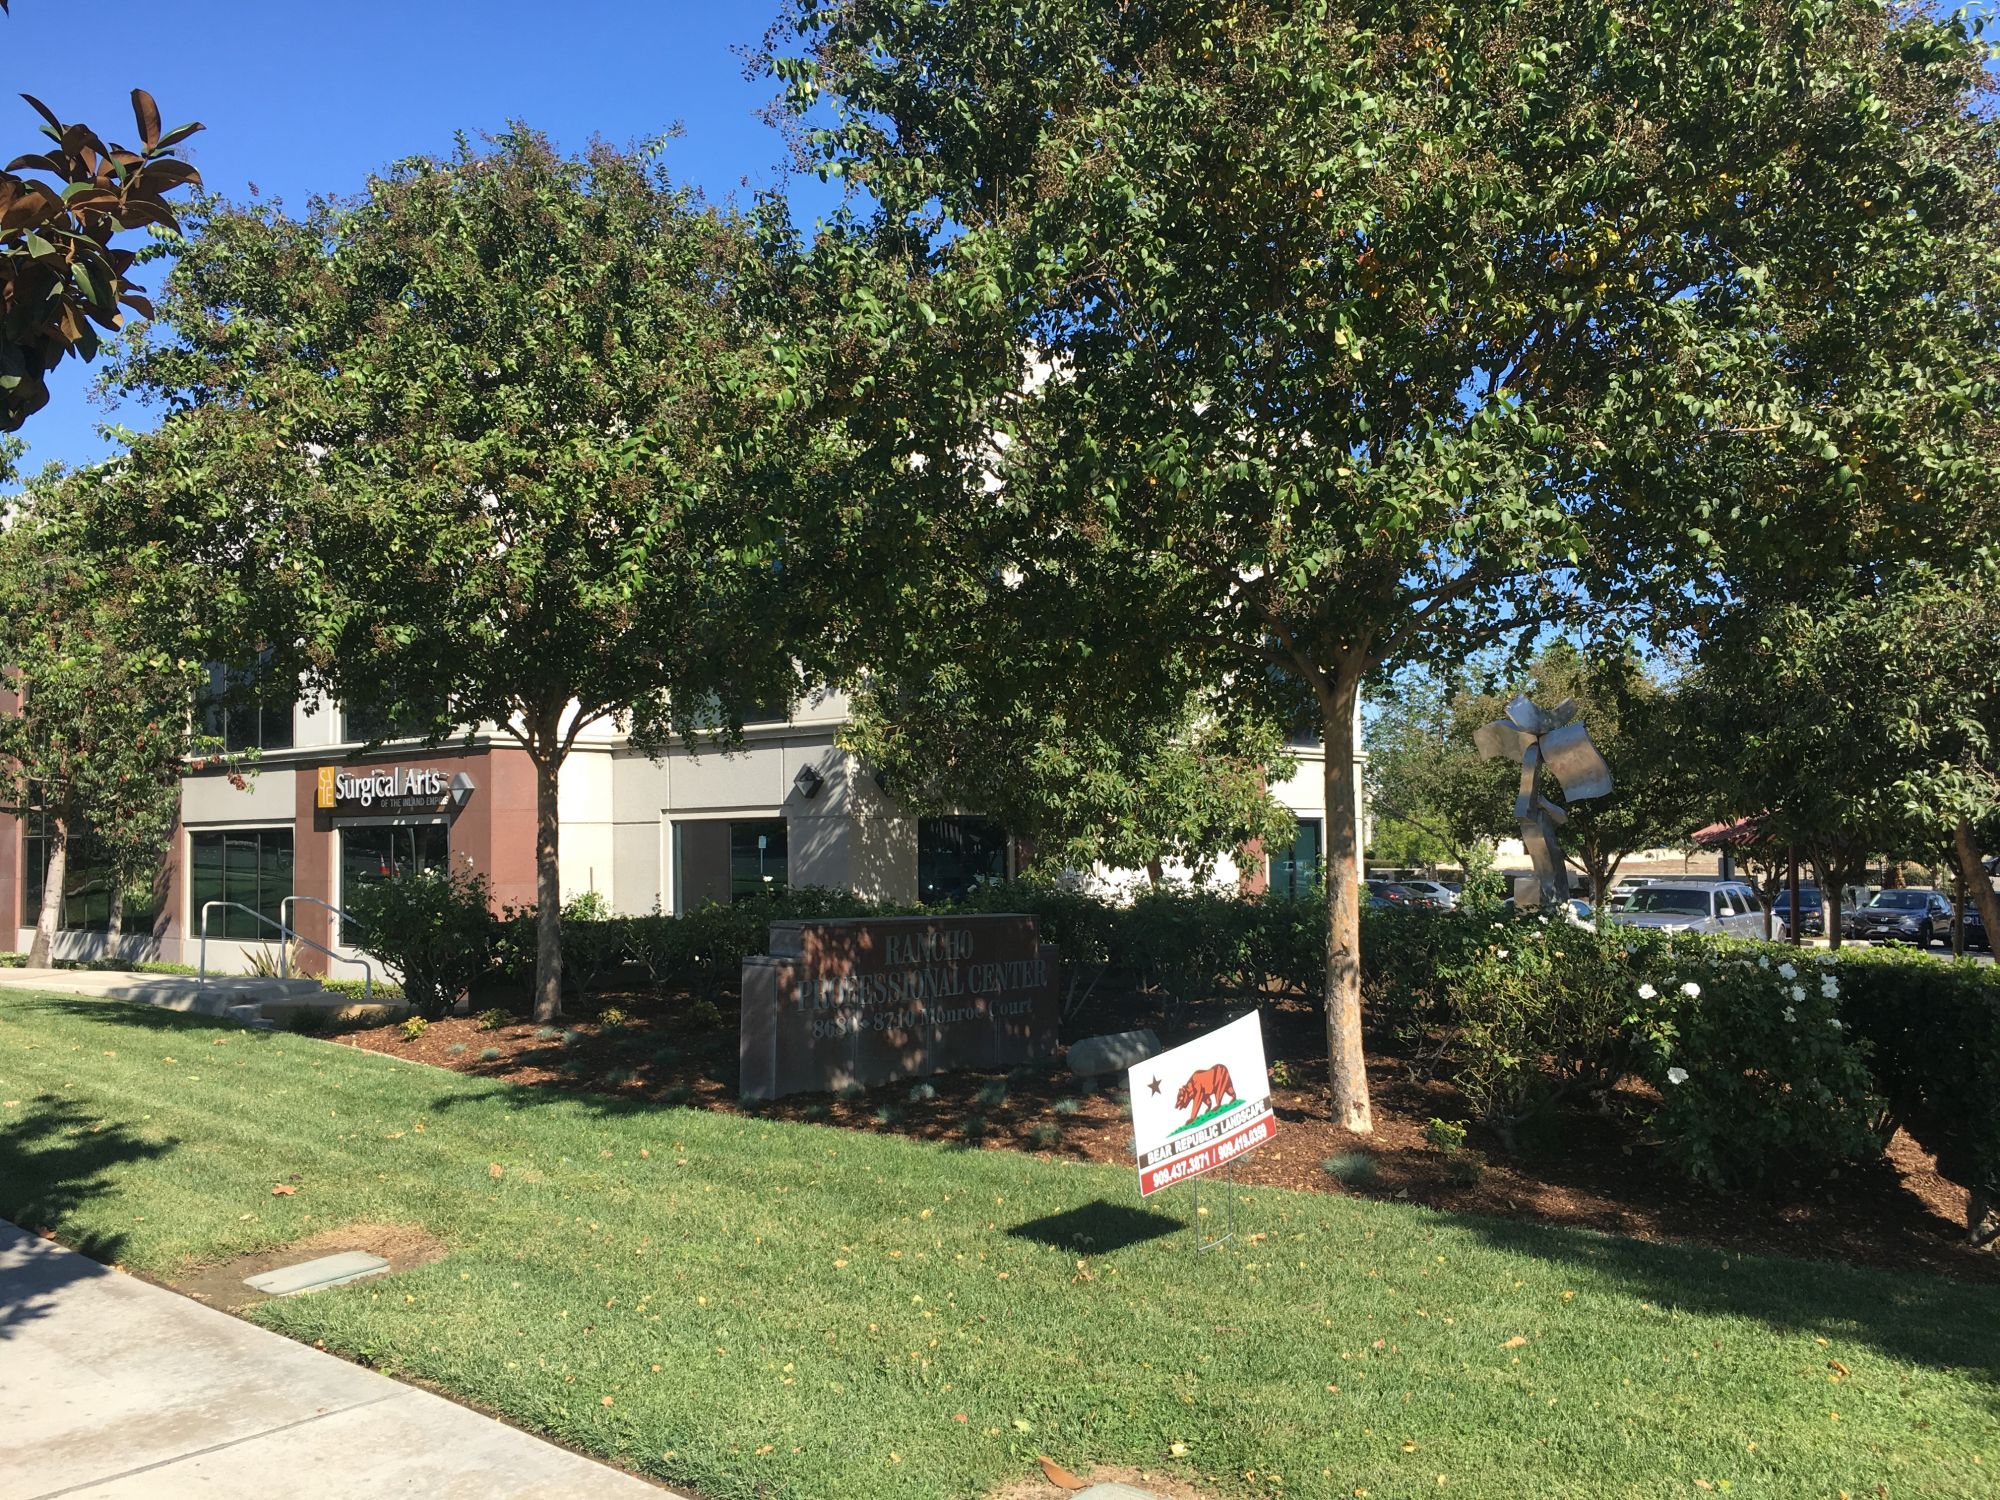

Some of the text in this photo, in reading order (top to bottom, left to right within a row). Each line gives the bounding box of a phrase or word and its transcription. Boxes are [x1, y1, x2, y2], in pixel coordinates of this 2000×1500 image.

[336, 767, 441, 807] Surgical Arts
[380, 800, 389, 808] OF
[390, 799, 401, 808] THE
[402, 797, 425, 807] INLAND
[885, 929, 974, 965] RANCHO
[796, 959, 1048, 1011] PROFESSIONAL CENTER
[920, 1006, 986, 1026] Monroe
[989, 998, 1033, 1018] Court
[1147, 1101, 1266, 1166] BEAR REPUBLIC LANDSCAPE
